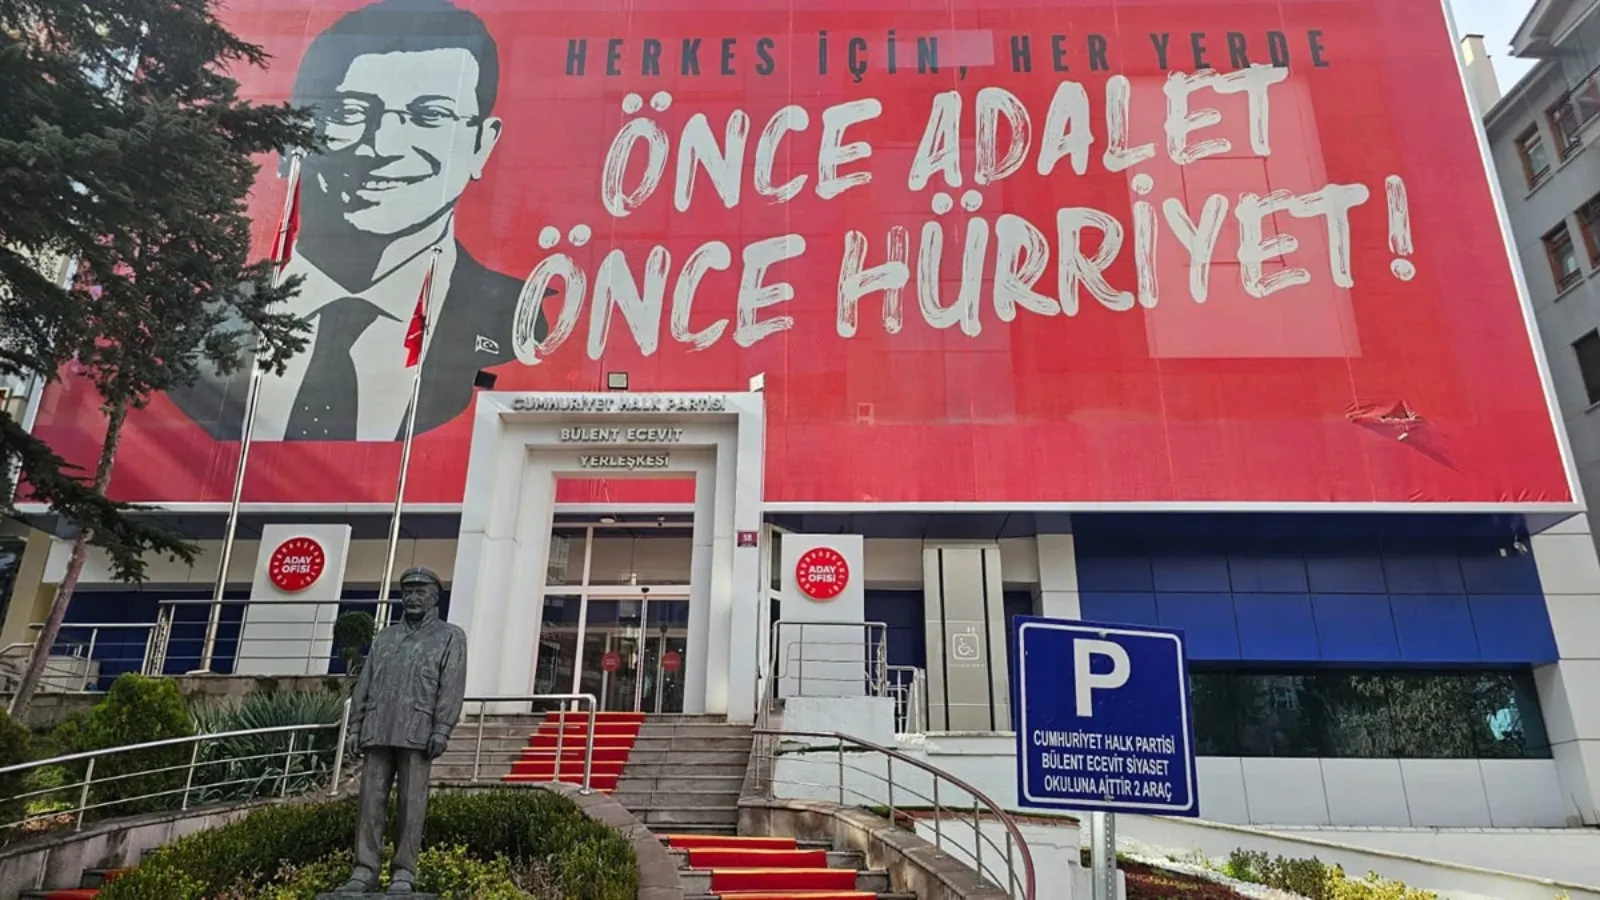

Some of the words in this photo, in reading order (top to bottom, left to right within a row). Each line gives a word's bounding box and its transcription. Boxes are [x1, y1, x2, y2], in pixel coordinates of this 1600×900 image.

[565, 37, 775, 77] HERKES
[817, 30, 968, 83] İÇİN,
[1010, 33, 1110, 73] HER
[1149, 29, 1330, 69] YERDE
[602, 91, 882, 217] ÖNCE
[907, 63, 1288, 191] ADALET
[511, 223, 806, 365] ÖNCE
[512, 394, 614, 411] CUMHURİYET
[619, 396, 660, 411] HALK
[666, 394, 726, 411] PARTİSİ
[561, 426, 620, 442] BÜLENT
[579, 453, 670, 470] YERLEŞKESİ
[283, 556, 312, 564] ADAY
[808, 565, 836, 573] ADAY
[1073, 638, 1131, 717] P
[1033, 729, 1102, 751] CUMHURİYET
[1105, 734, 1133, 751] HALK
[1136, 735, 1175, 754] PARTİSİ
[1042, 750, 1084, 771] BÜLENT
[1087, 753, 1123, 773] ECEVİT
[1127, 755, 1169, 776] SİYASET
[1044, 775, 1097, 794] OKULUNA
[1098, 775, 1132, 796] AİTTİR
[1134, 781, 1140, 796] 2
[1143, 782, 1172, 802] ARAÇ
